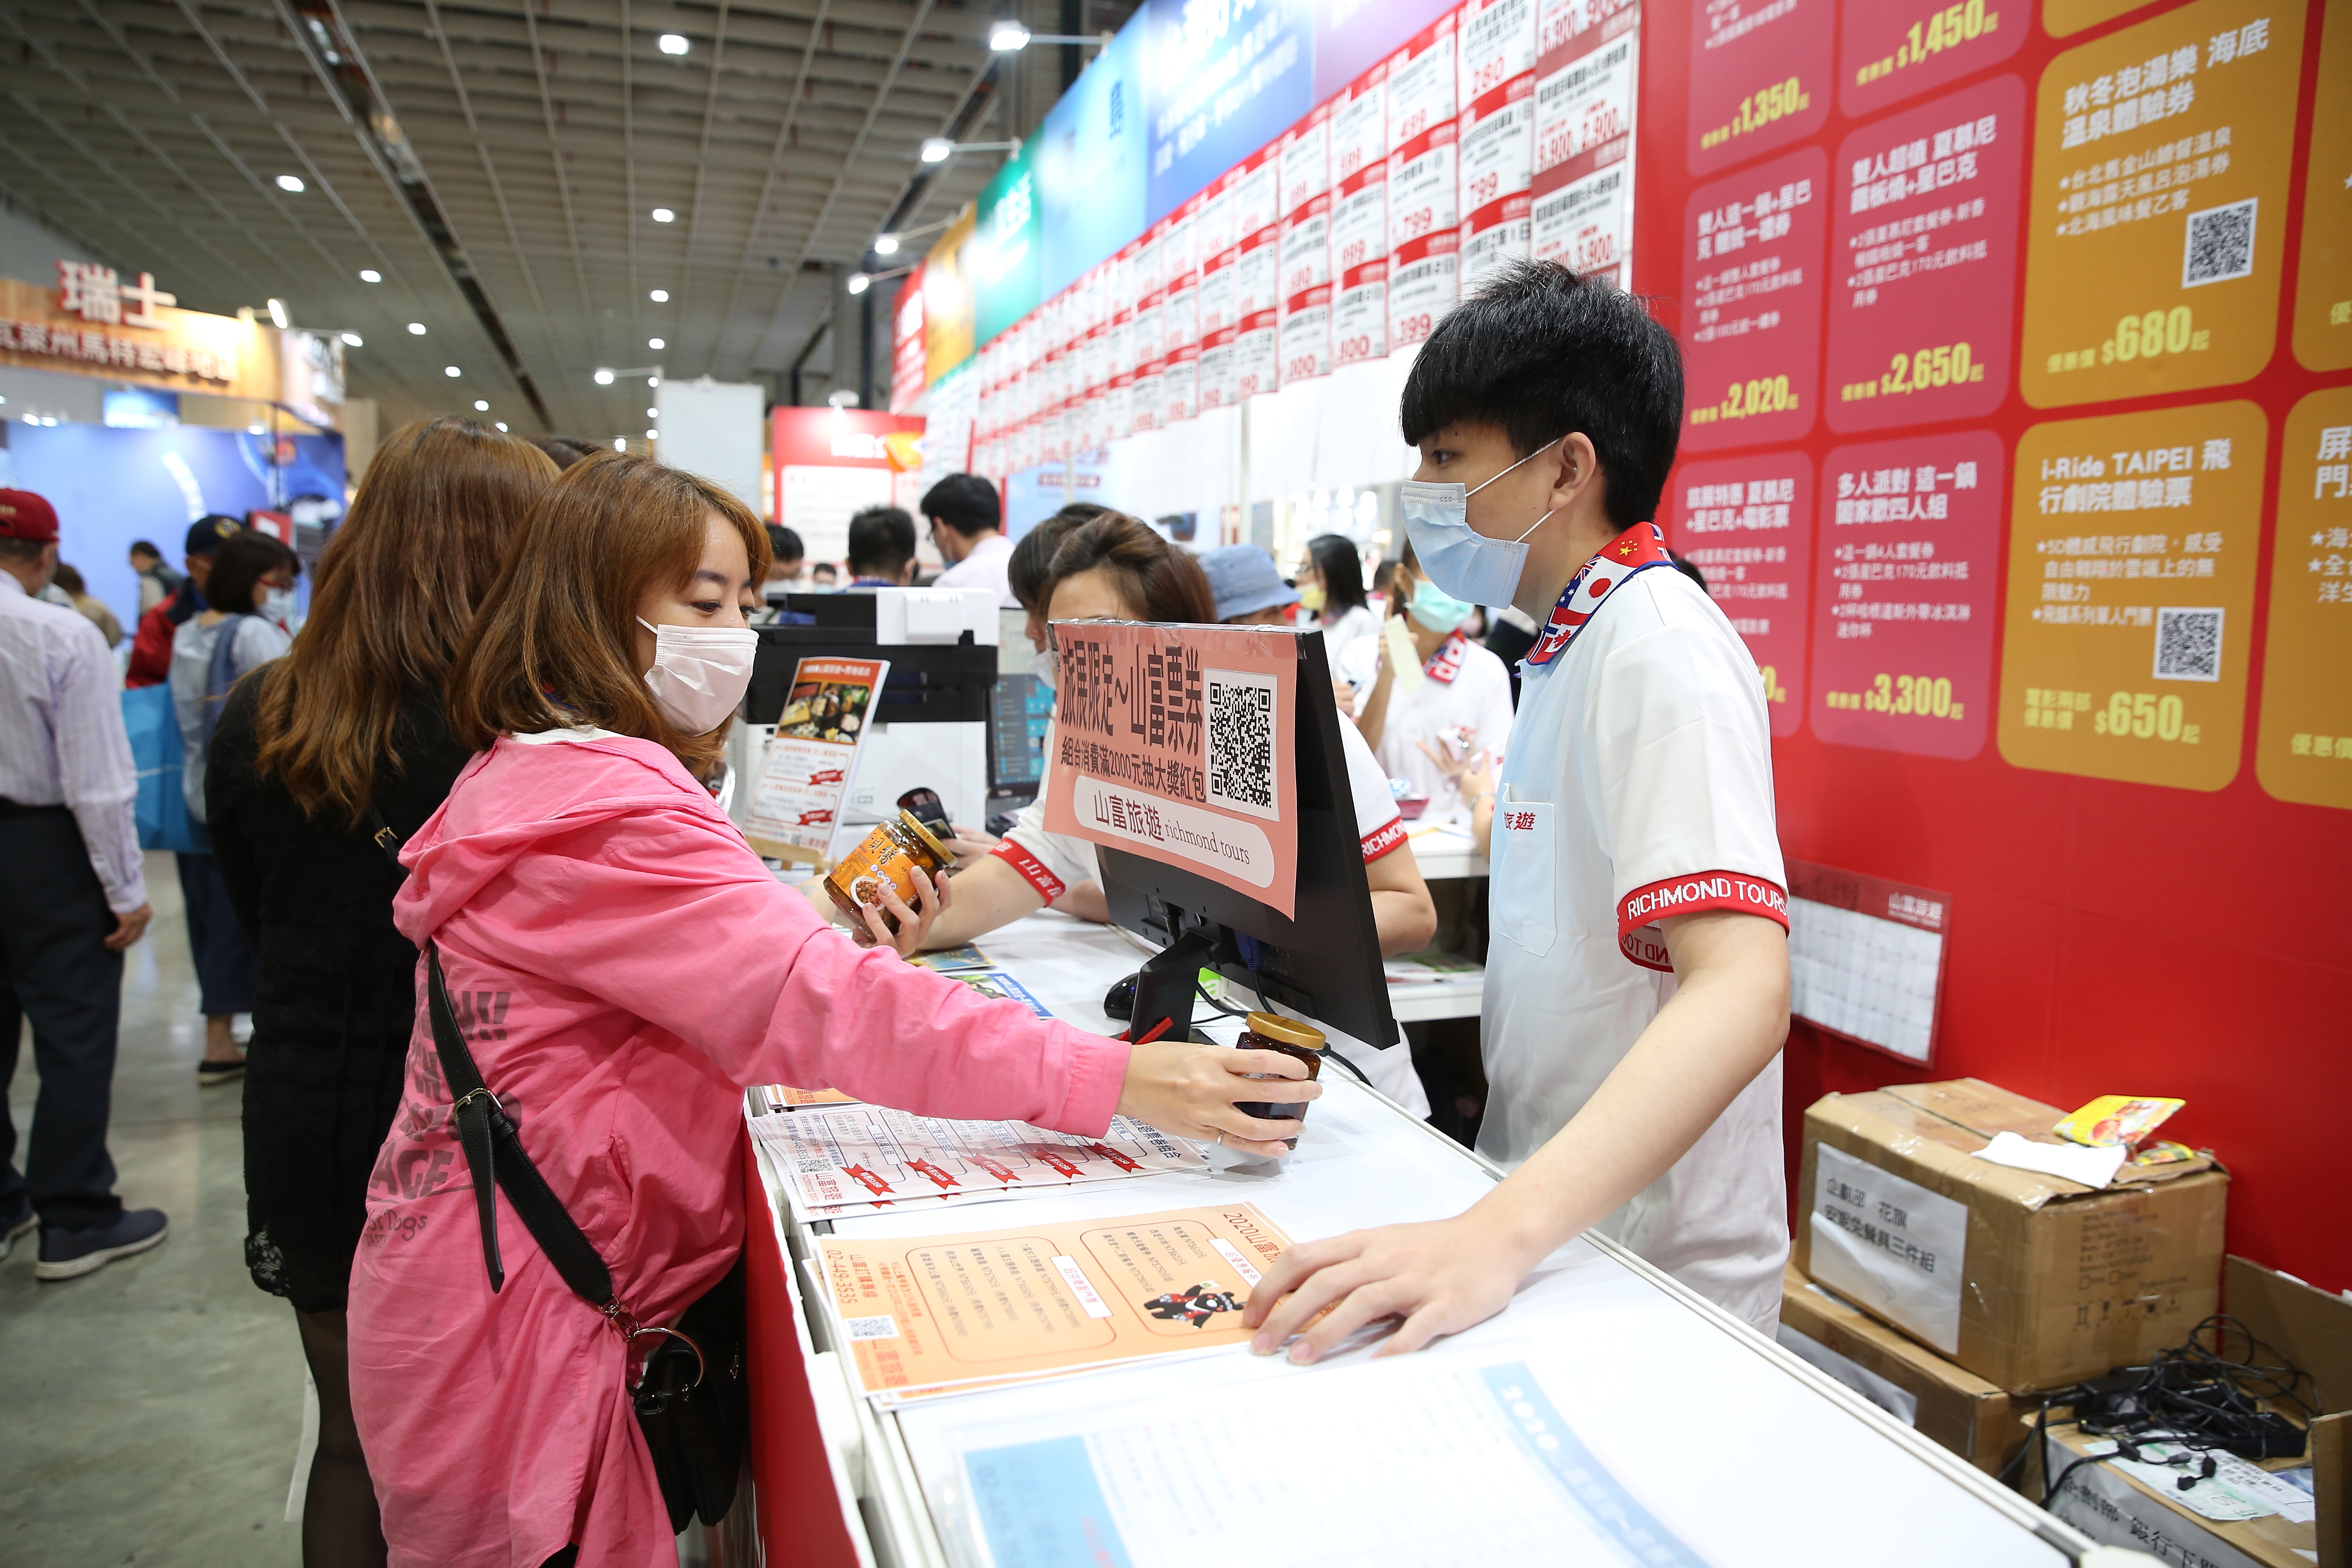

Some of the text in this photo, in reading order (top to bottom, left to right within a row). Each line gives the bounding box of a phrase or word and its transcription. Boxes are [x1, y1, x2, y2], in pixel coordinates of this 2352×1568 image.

[2063, 18, 2270, 116] 秋冬泡湯樂 海底
[2061, 81, 2195, 149] 溫泉體驗券
[1851, 114, 1997, 187] 雙人超值 夏慕尼
[1850, 151, 1979, 215] 鐵板燒+星巴克
[56, 260, 178, 330] 瑞士
[2101, 305, 2210, 365] $680起
[1880, 341, 1985, 395] $2,650起
[1720, 374, 1799, 420] $2,020起
[1837, 461, 1978, 499] 多人派對 這一鍋
[2041, 437, 2233, 481] i-Ride TAIPEI 飛
[2038, 475, 2194, 515] 行劇院體驗票
[2314, 463, 2352, 501] 門
[2325, 526, 2352, 549] 海
[2322, 554, 2352, 576] 全
[2041, 581, 2091, 602] 限魅力
[1864, 672, 1965, 722] $3,300起
[2023, 707, 2074, 731] 優惠價
[2094, 691, 2201, 745] $650起
[1060, 735, 1206, 803] 組合消費滿2000元抽大獎紅包
[1094, 790, 1251, 866] 山富旅遊 richmond tours
[1627, 878, 1787, 920] RICHMOND TOURS
[815, 1172, 844, 1200] 山富旅遊
[923, 1165, 949, 1182] 特惠$2020
[1826, 1177, 1866, 1209] 企劃部
[826, 1249, 858, 1304] 02-449-3535
[850, 1254, 878, 1298] 山富訂購專線
[1063, 1267, 1099, 1304] 超夯樂園門票
